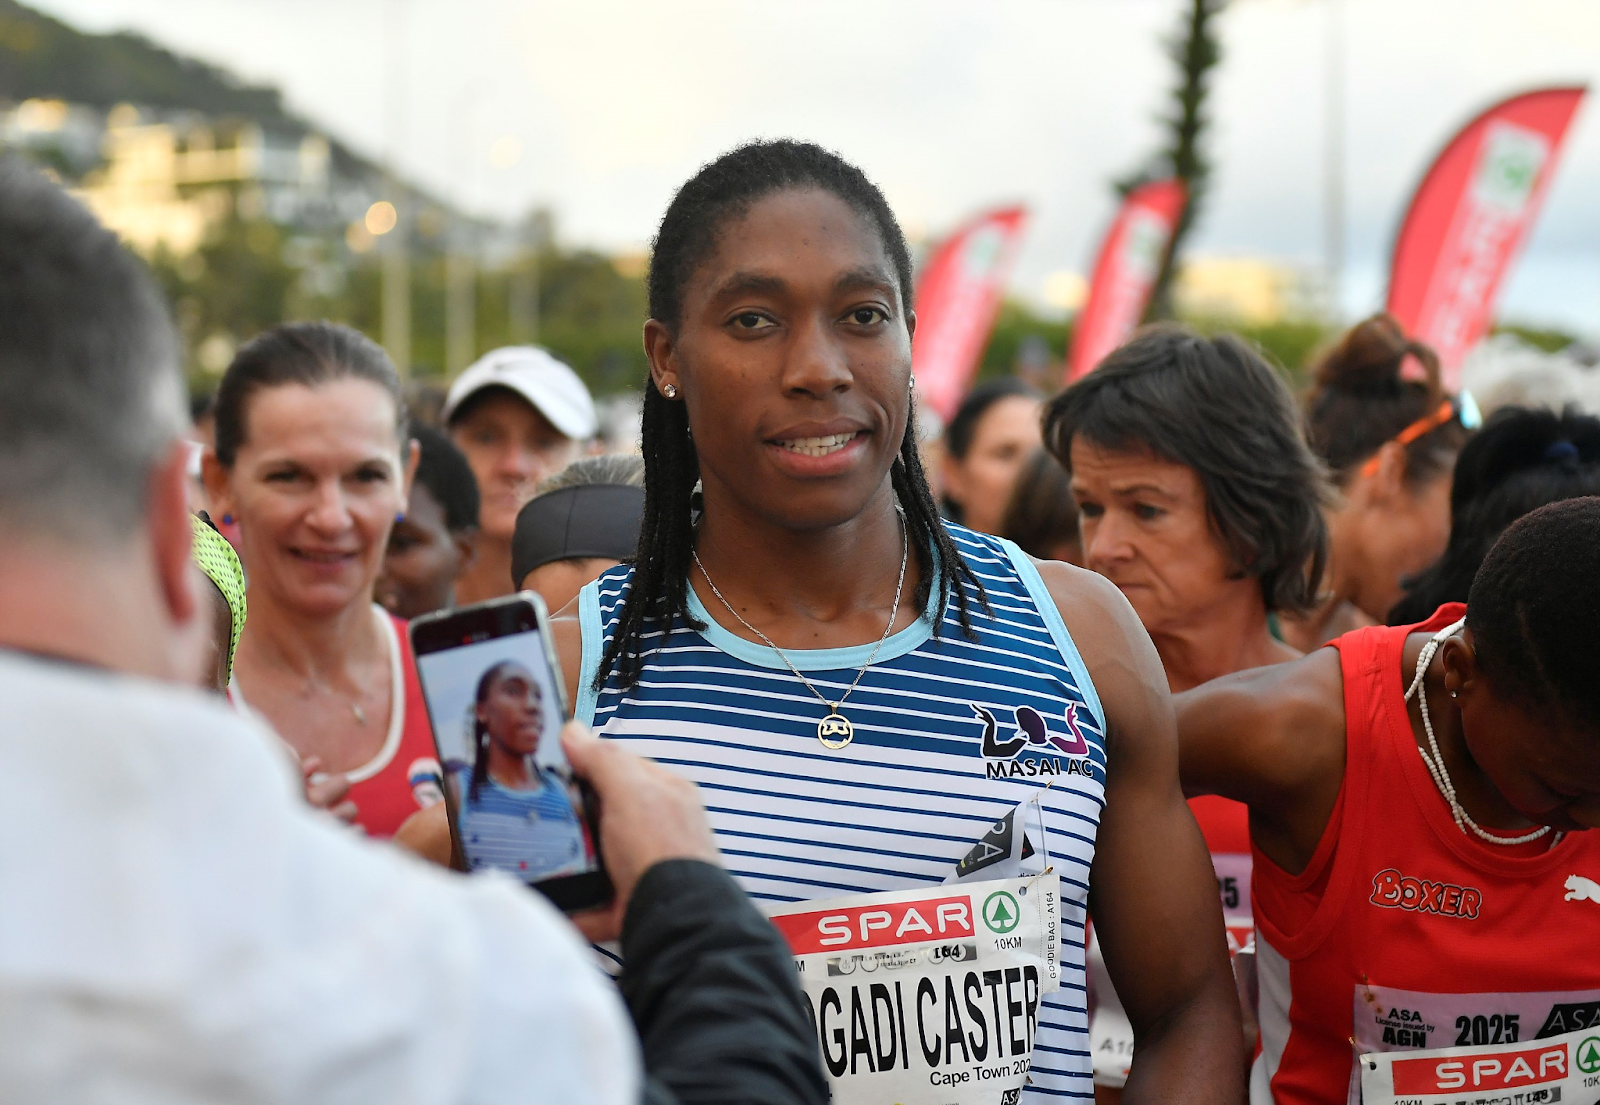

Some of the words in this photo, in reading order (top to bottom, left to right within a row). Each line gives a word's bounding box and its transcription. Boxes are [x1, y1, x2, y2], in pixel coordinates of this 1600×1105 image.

[986, 758, 1061, 779] MASAI
[1068, 758, 1094, 777] AC
[1046, 892, 1055, 914] A164
[818, 902, 971, 946] SPAR
[934, 944, 960, 959] 164
[994, 936, 1022, 950] 10KM
[1047, 943, 1057, 979] GOODIE
[917, 965, 1038, 1067] CASTER
[1388, 1008, 1422, 1022] ASA
[1382, 1026, 1426, 1048] AGN
[1427, 1024, 1435, 1033] by
[1455, 1014, 1520, 1046] 2025
[930, 1071, 970, 1087] Cape
[973, 1066, 1010, 1081] Town
[1013, 1058, 1031, 1075] 202
[1436, 1050, 1565, 1089] SPAR
[1583, 1078, 1600, 1088] 10K
